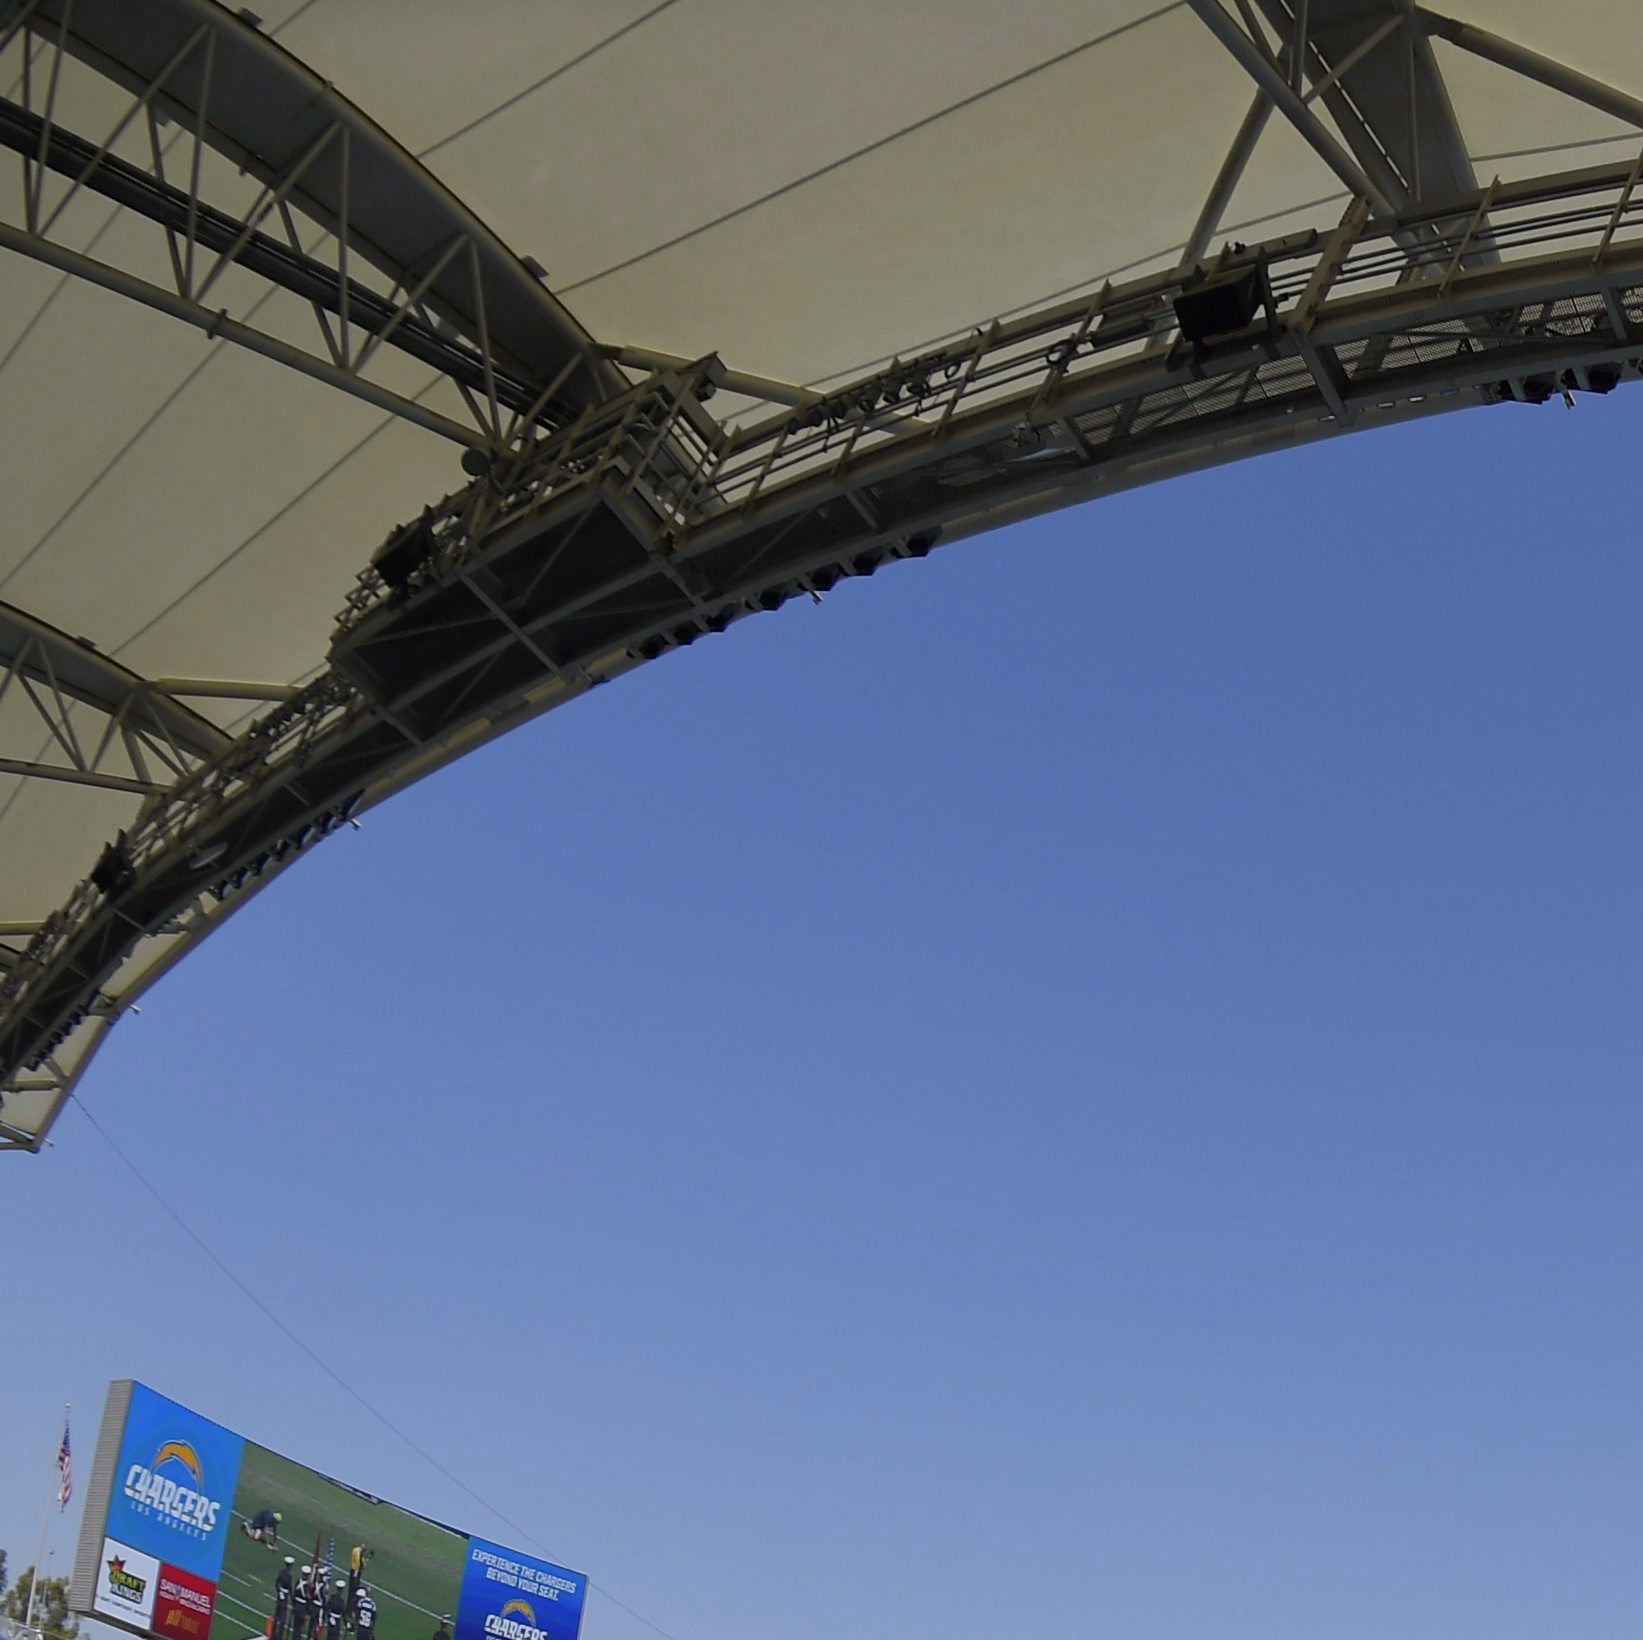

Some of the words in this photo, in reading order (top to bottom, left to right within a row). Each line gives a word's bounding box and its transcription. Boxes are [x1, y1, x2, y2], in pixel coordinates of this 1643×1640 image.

[124, 1464, 221, 1533] CHARGERS
[112, 1569, 146, 1590] DRAFT
[472, 1549, 521, 1577] EXPERIENCE
[521, 1563, 536, 1580] THE
[536, 1568, 576, 1594] CHARGERS
[486, 1567, 518, 1588] BEYOND
[518, 1577, 540, 1595] YOUR
[111, 1584, 143, 1605] KINGS
[160, 1579, 176, 1595] SAN
[180, 1586, 211, 1609] MANUEL
